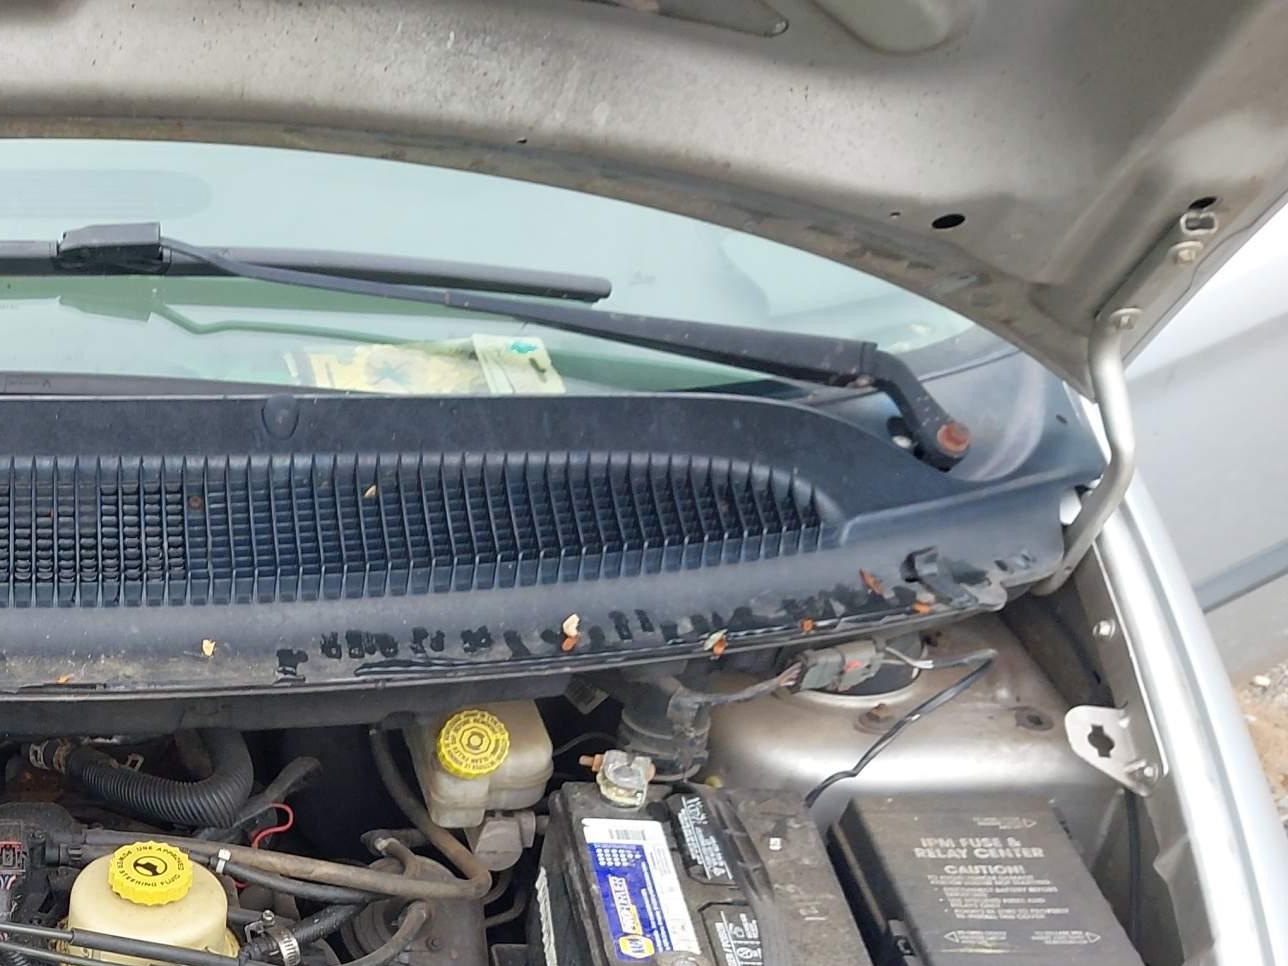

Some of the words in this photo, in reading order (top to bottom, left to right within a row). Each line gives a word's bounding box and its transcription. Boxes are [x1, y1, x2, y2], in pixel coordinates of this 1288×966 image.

[920, 838, 956, 848] IPM
[960, 838, 1002, 848] FUSE
[1007, 837, 1022, 847] &
[914, 848, 968, 858] RELAY
[974, 848, 1044, 858] CENTER
[944, 864, 1026, 874] CAUTION!
